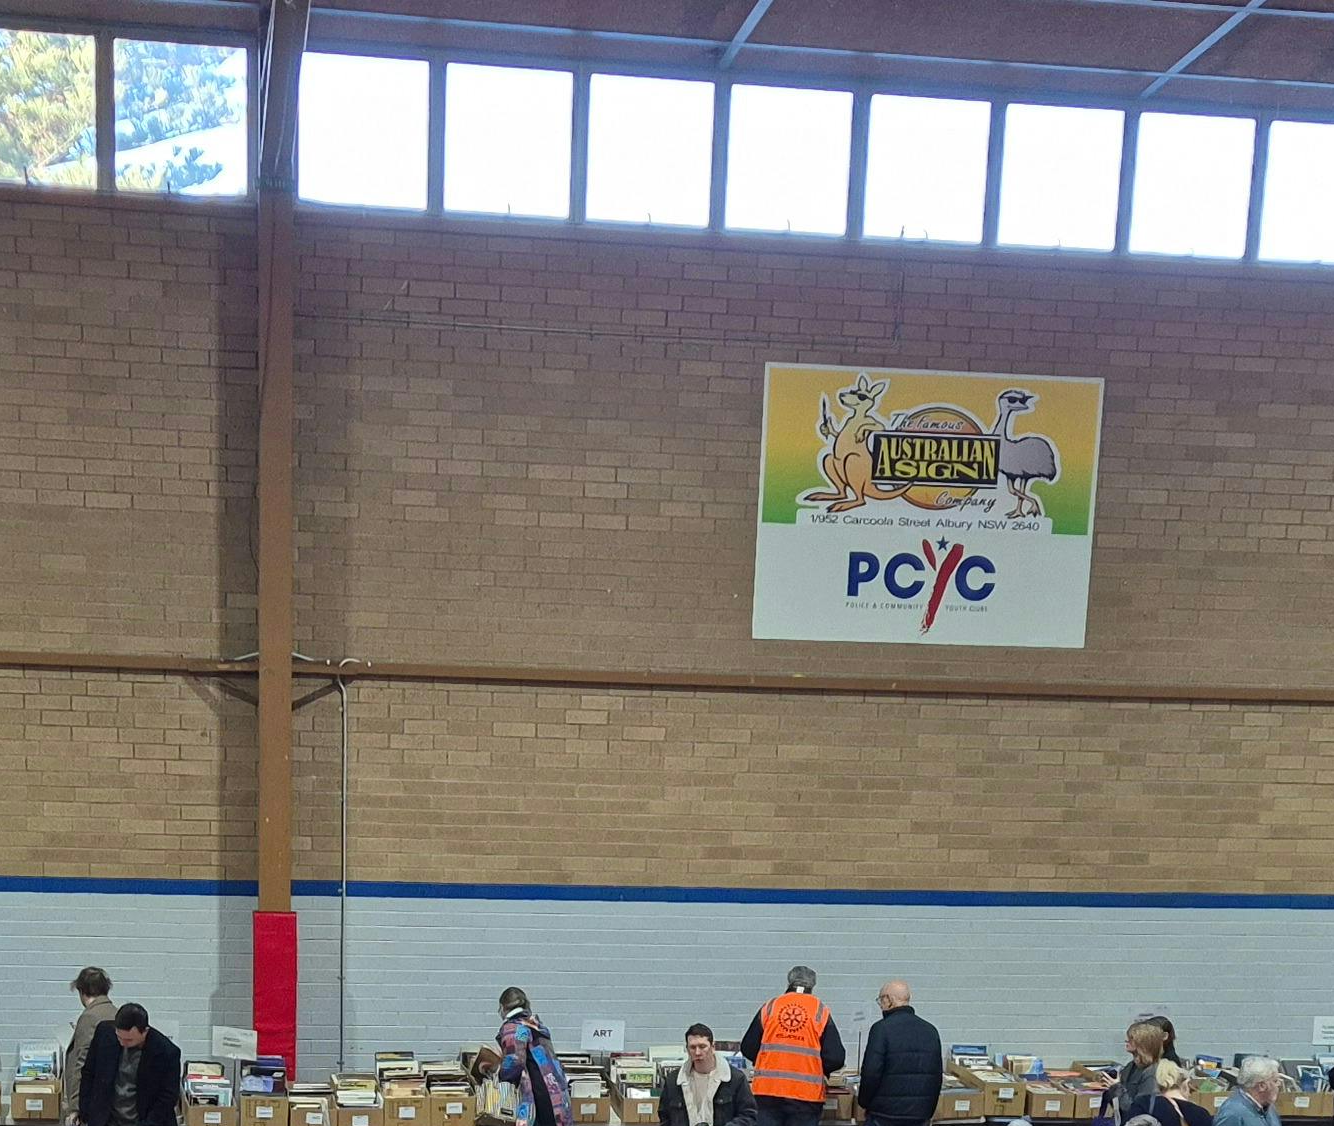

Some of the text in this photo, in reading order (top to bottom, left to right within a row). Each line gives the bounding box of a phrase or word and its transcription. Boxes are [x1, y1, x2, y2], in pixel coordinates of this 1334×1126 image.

[889, 412, 964, 431] The Famous
[875, 436, 998, 480] AUSTRALIAN
[893, 459, 981, 479] SIGN
[934, 490, 997, 512] Company
[810, 513, 1041, 532] 1/952 Carcoola Street Albury NSW 2640
[847, 539, 996, 635] PCYC
[592, 1029, 613, 1038] ART
